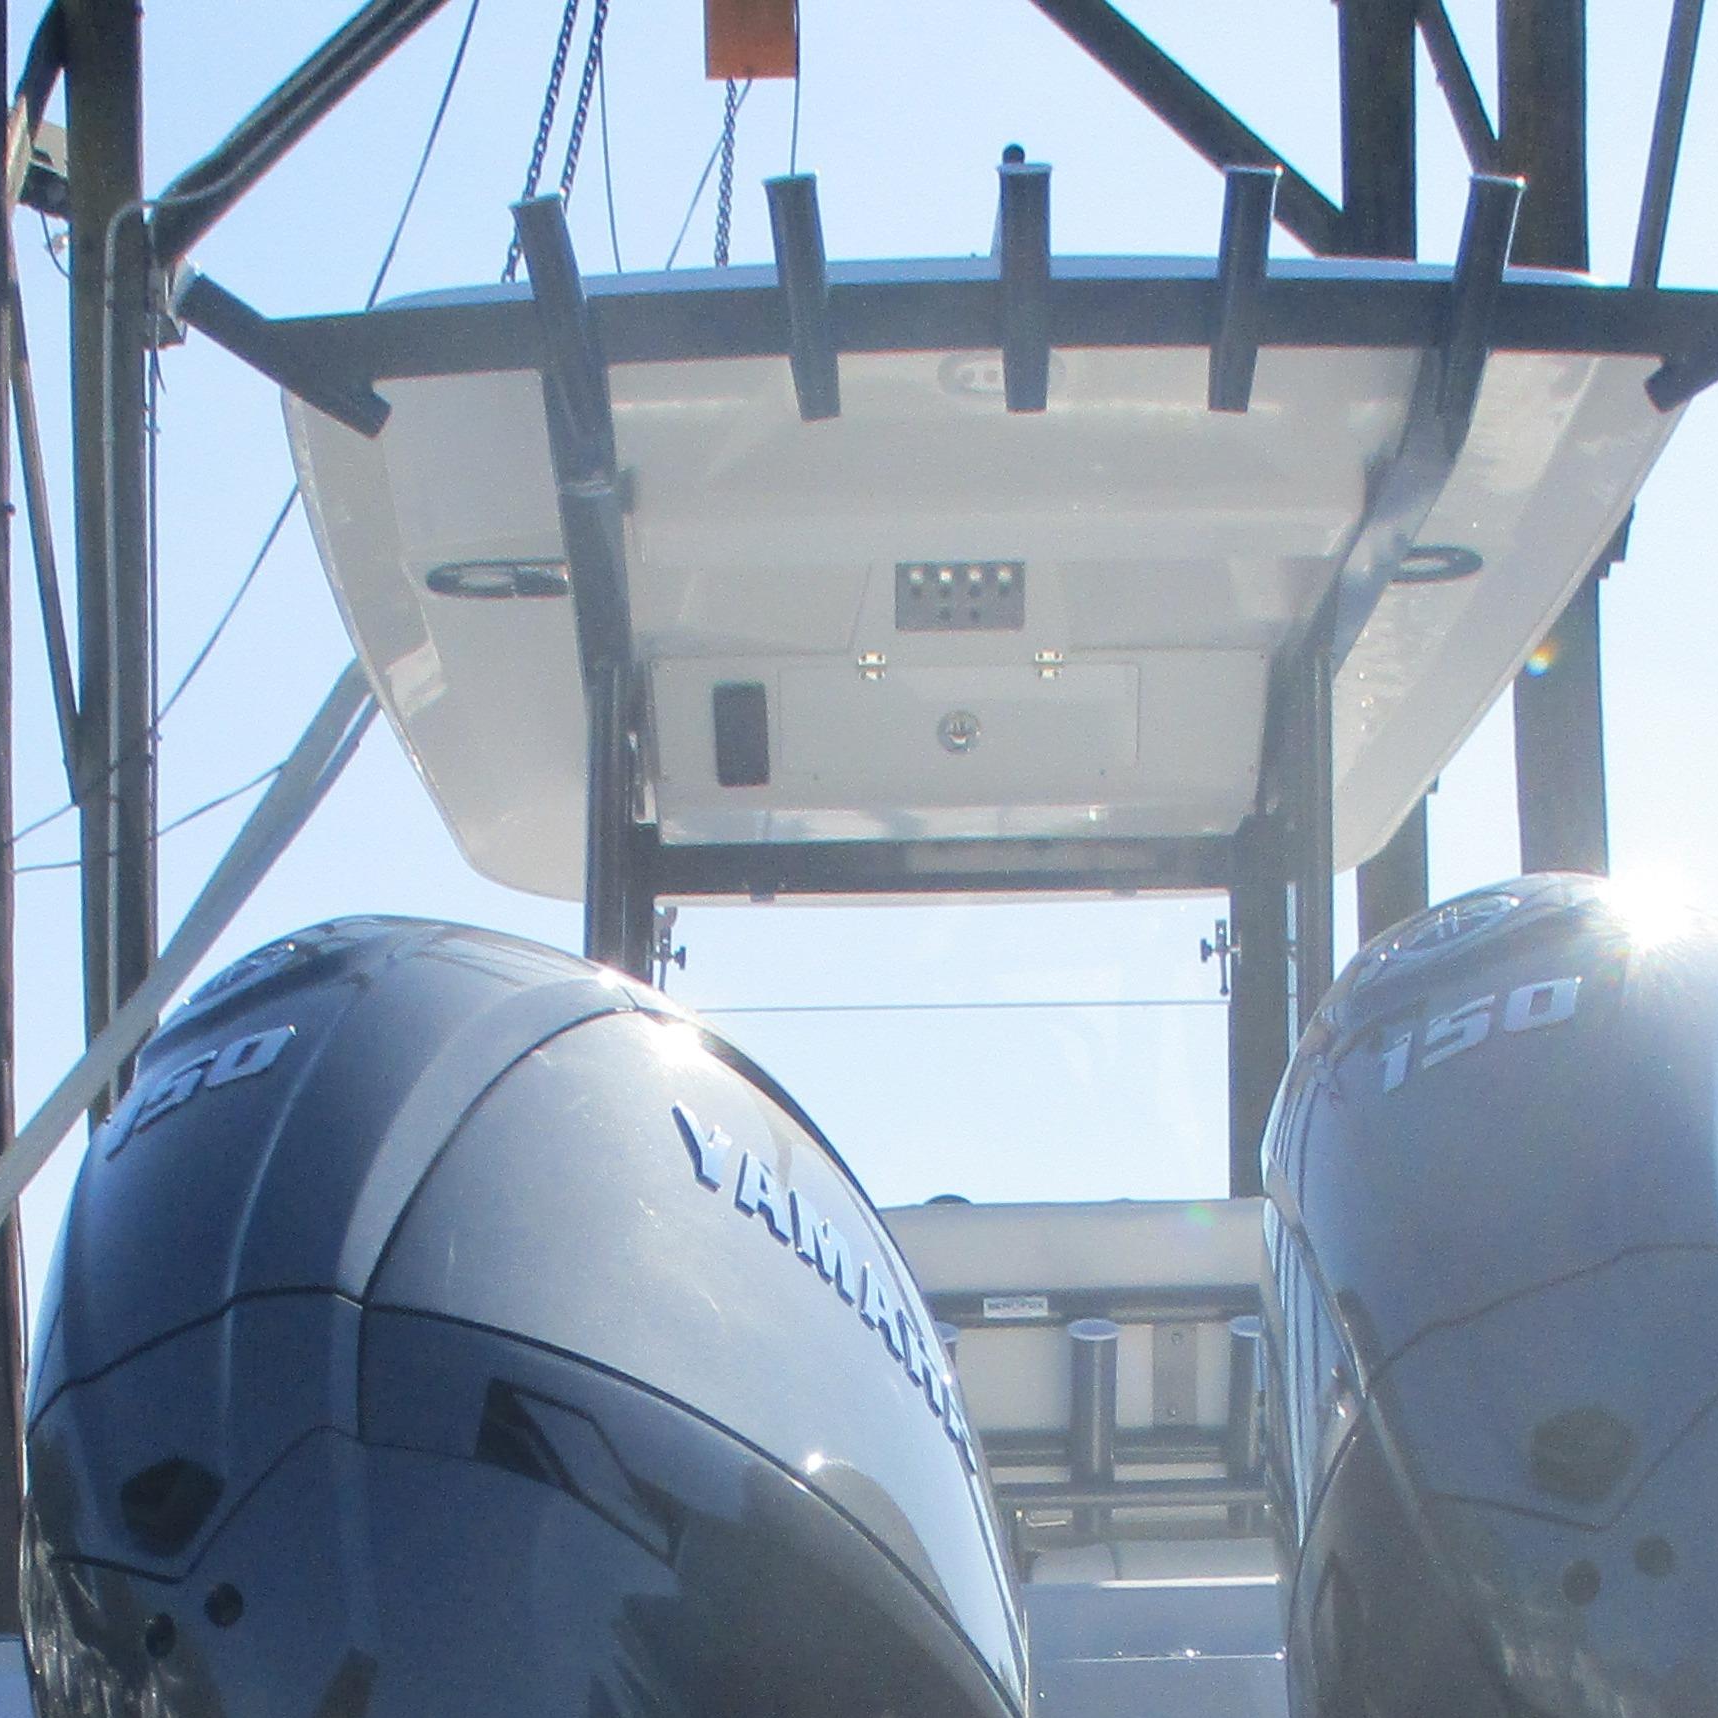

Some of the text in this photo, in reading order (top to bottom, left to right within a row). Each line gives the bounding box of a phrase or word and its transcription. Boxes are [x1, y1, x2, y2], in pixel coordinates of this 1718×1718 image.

[104, 1024, 298, 1161] 150
[1381, 976, 1582, 1095] 150
[671, 1100, 980, 1475] YAMAHA
